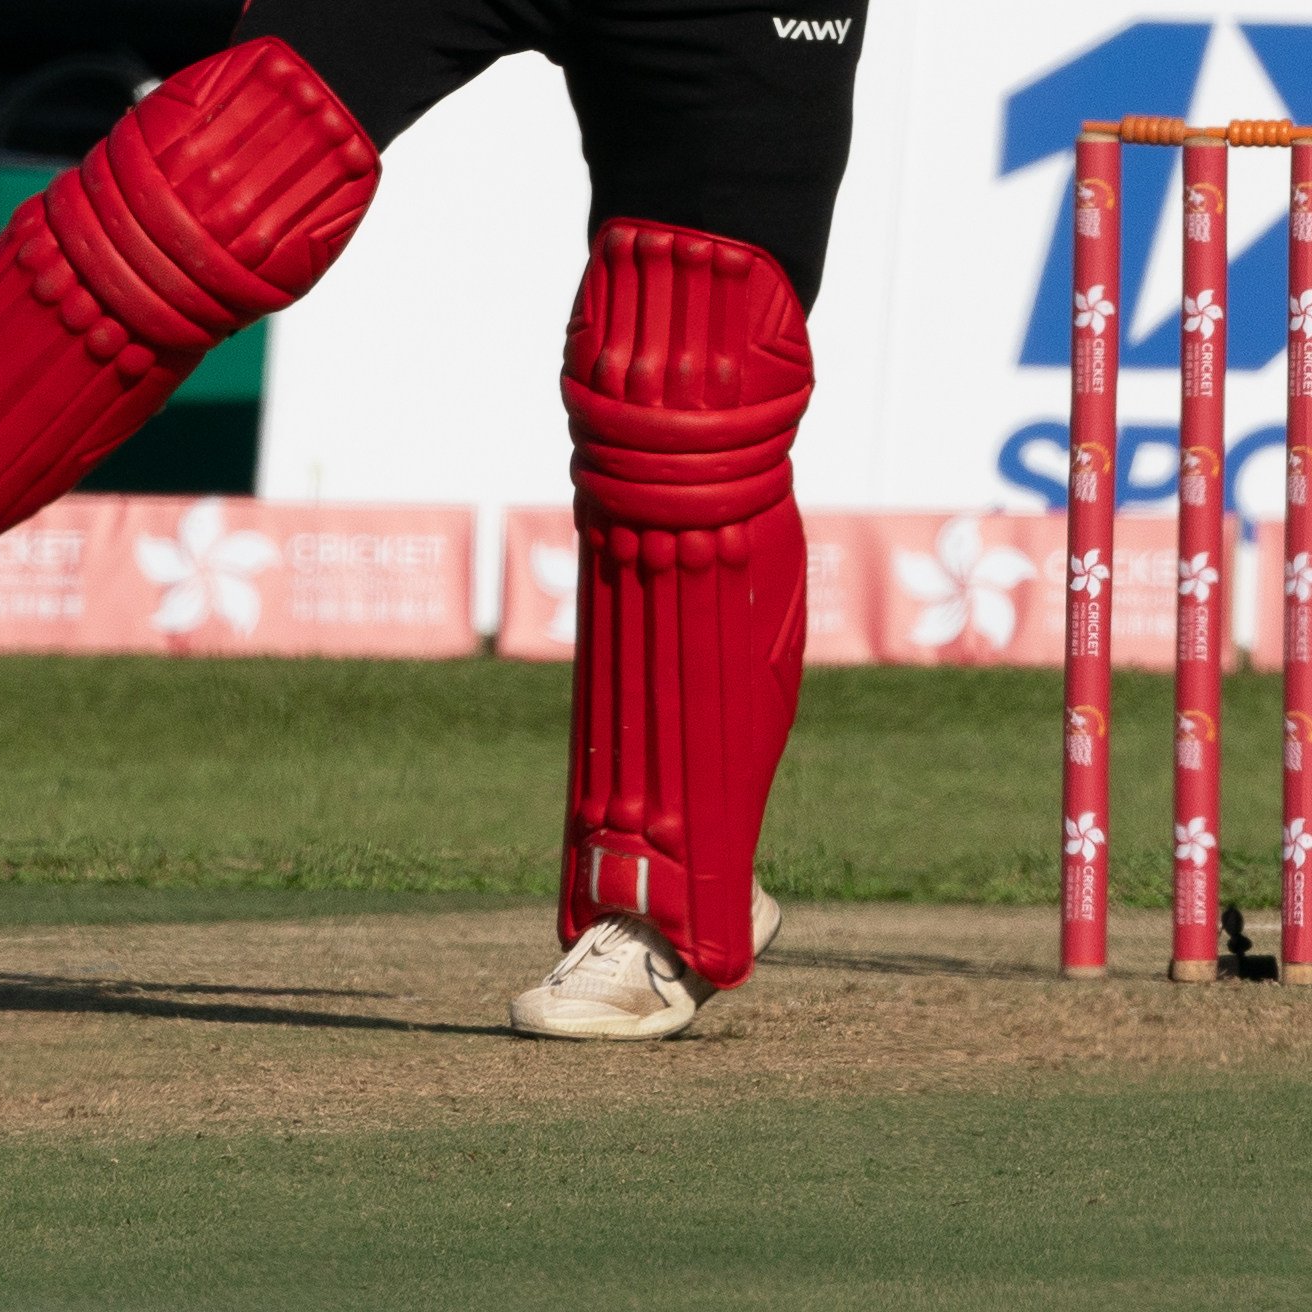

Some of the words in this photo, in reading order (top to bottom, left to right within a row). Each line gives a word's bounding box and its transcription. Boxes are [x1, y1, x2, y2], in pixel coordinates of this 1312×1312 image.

[1092, 338, 1106, 395] CRICKET
[1200, 342, 1214, 397] CRICKET
[1088, 602, 1100, 657] CRICKET
[1195, 606, 1208, 662] CRICKET
[1082, 865, 1096, 921] CRICKET
[1293, 870, 1305, 927] CRICKET
